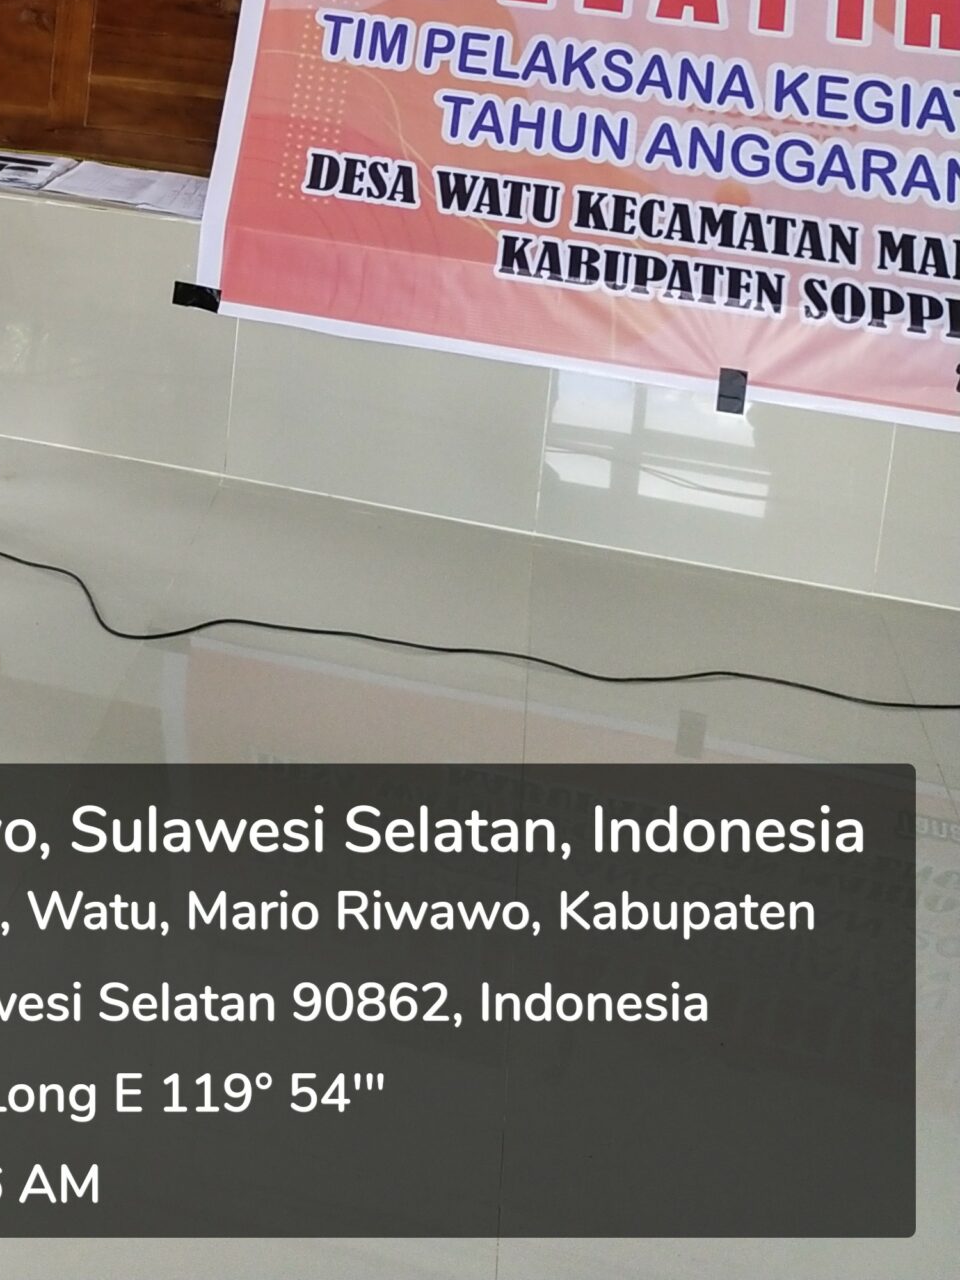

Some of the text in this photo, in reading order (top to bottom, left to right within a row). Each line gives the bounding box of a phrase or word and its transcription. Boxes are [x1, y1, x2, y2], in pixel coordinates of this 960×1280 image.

[323, 14, 960, 133] TIM PELAKSANA KEGIA
[442, 95, 629, 160] TAHUN
[306, 152, 416, 204] DESA
[437, 170, 561, 223] WATU
[574, 190, 859, 266] KECAMATAN
[498, 235, 786, 313] KABUPATEN
